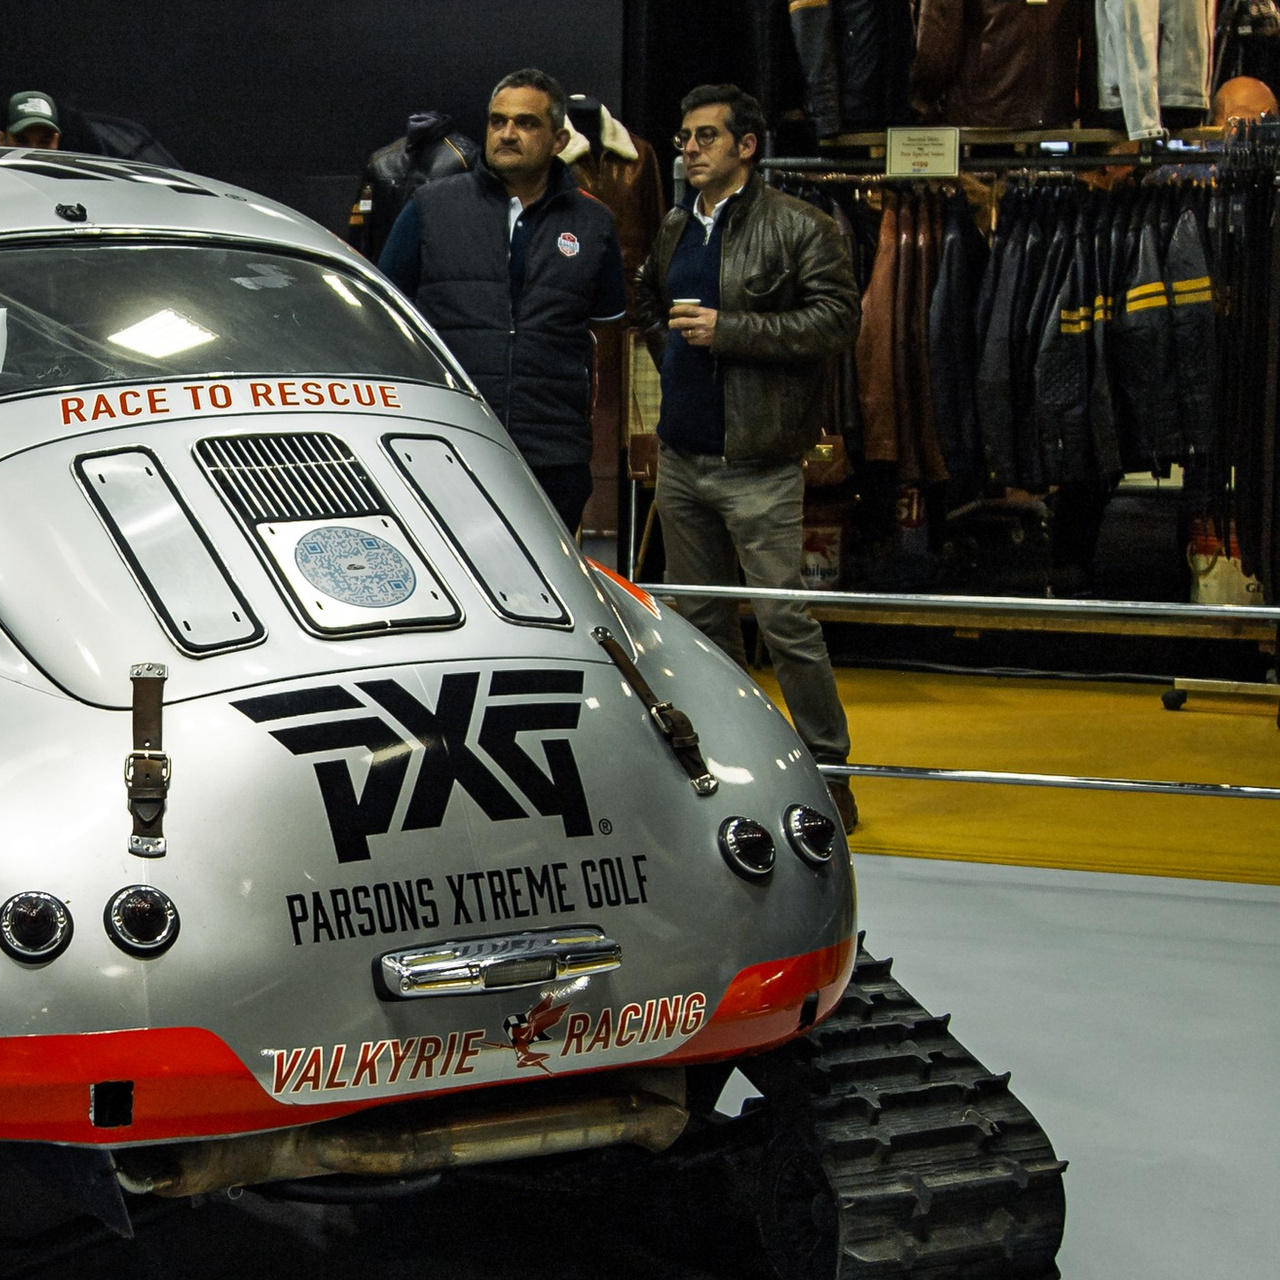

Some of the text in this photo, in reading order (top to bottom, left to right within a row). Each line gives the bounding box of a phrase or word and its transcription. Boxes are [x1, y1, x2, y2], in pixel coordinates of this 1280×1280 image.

[61, 381, 402, 426] RACE TO RESCUE
[229, 669, 595, 864] PXG
[286, 854, 649, 946] PARSONS XTREME GOLF
[270, 991, 708, 1096] VALKYRIE RACING
